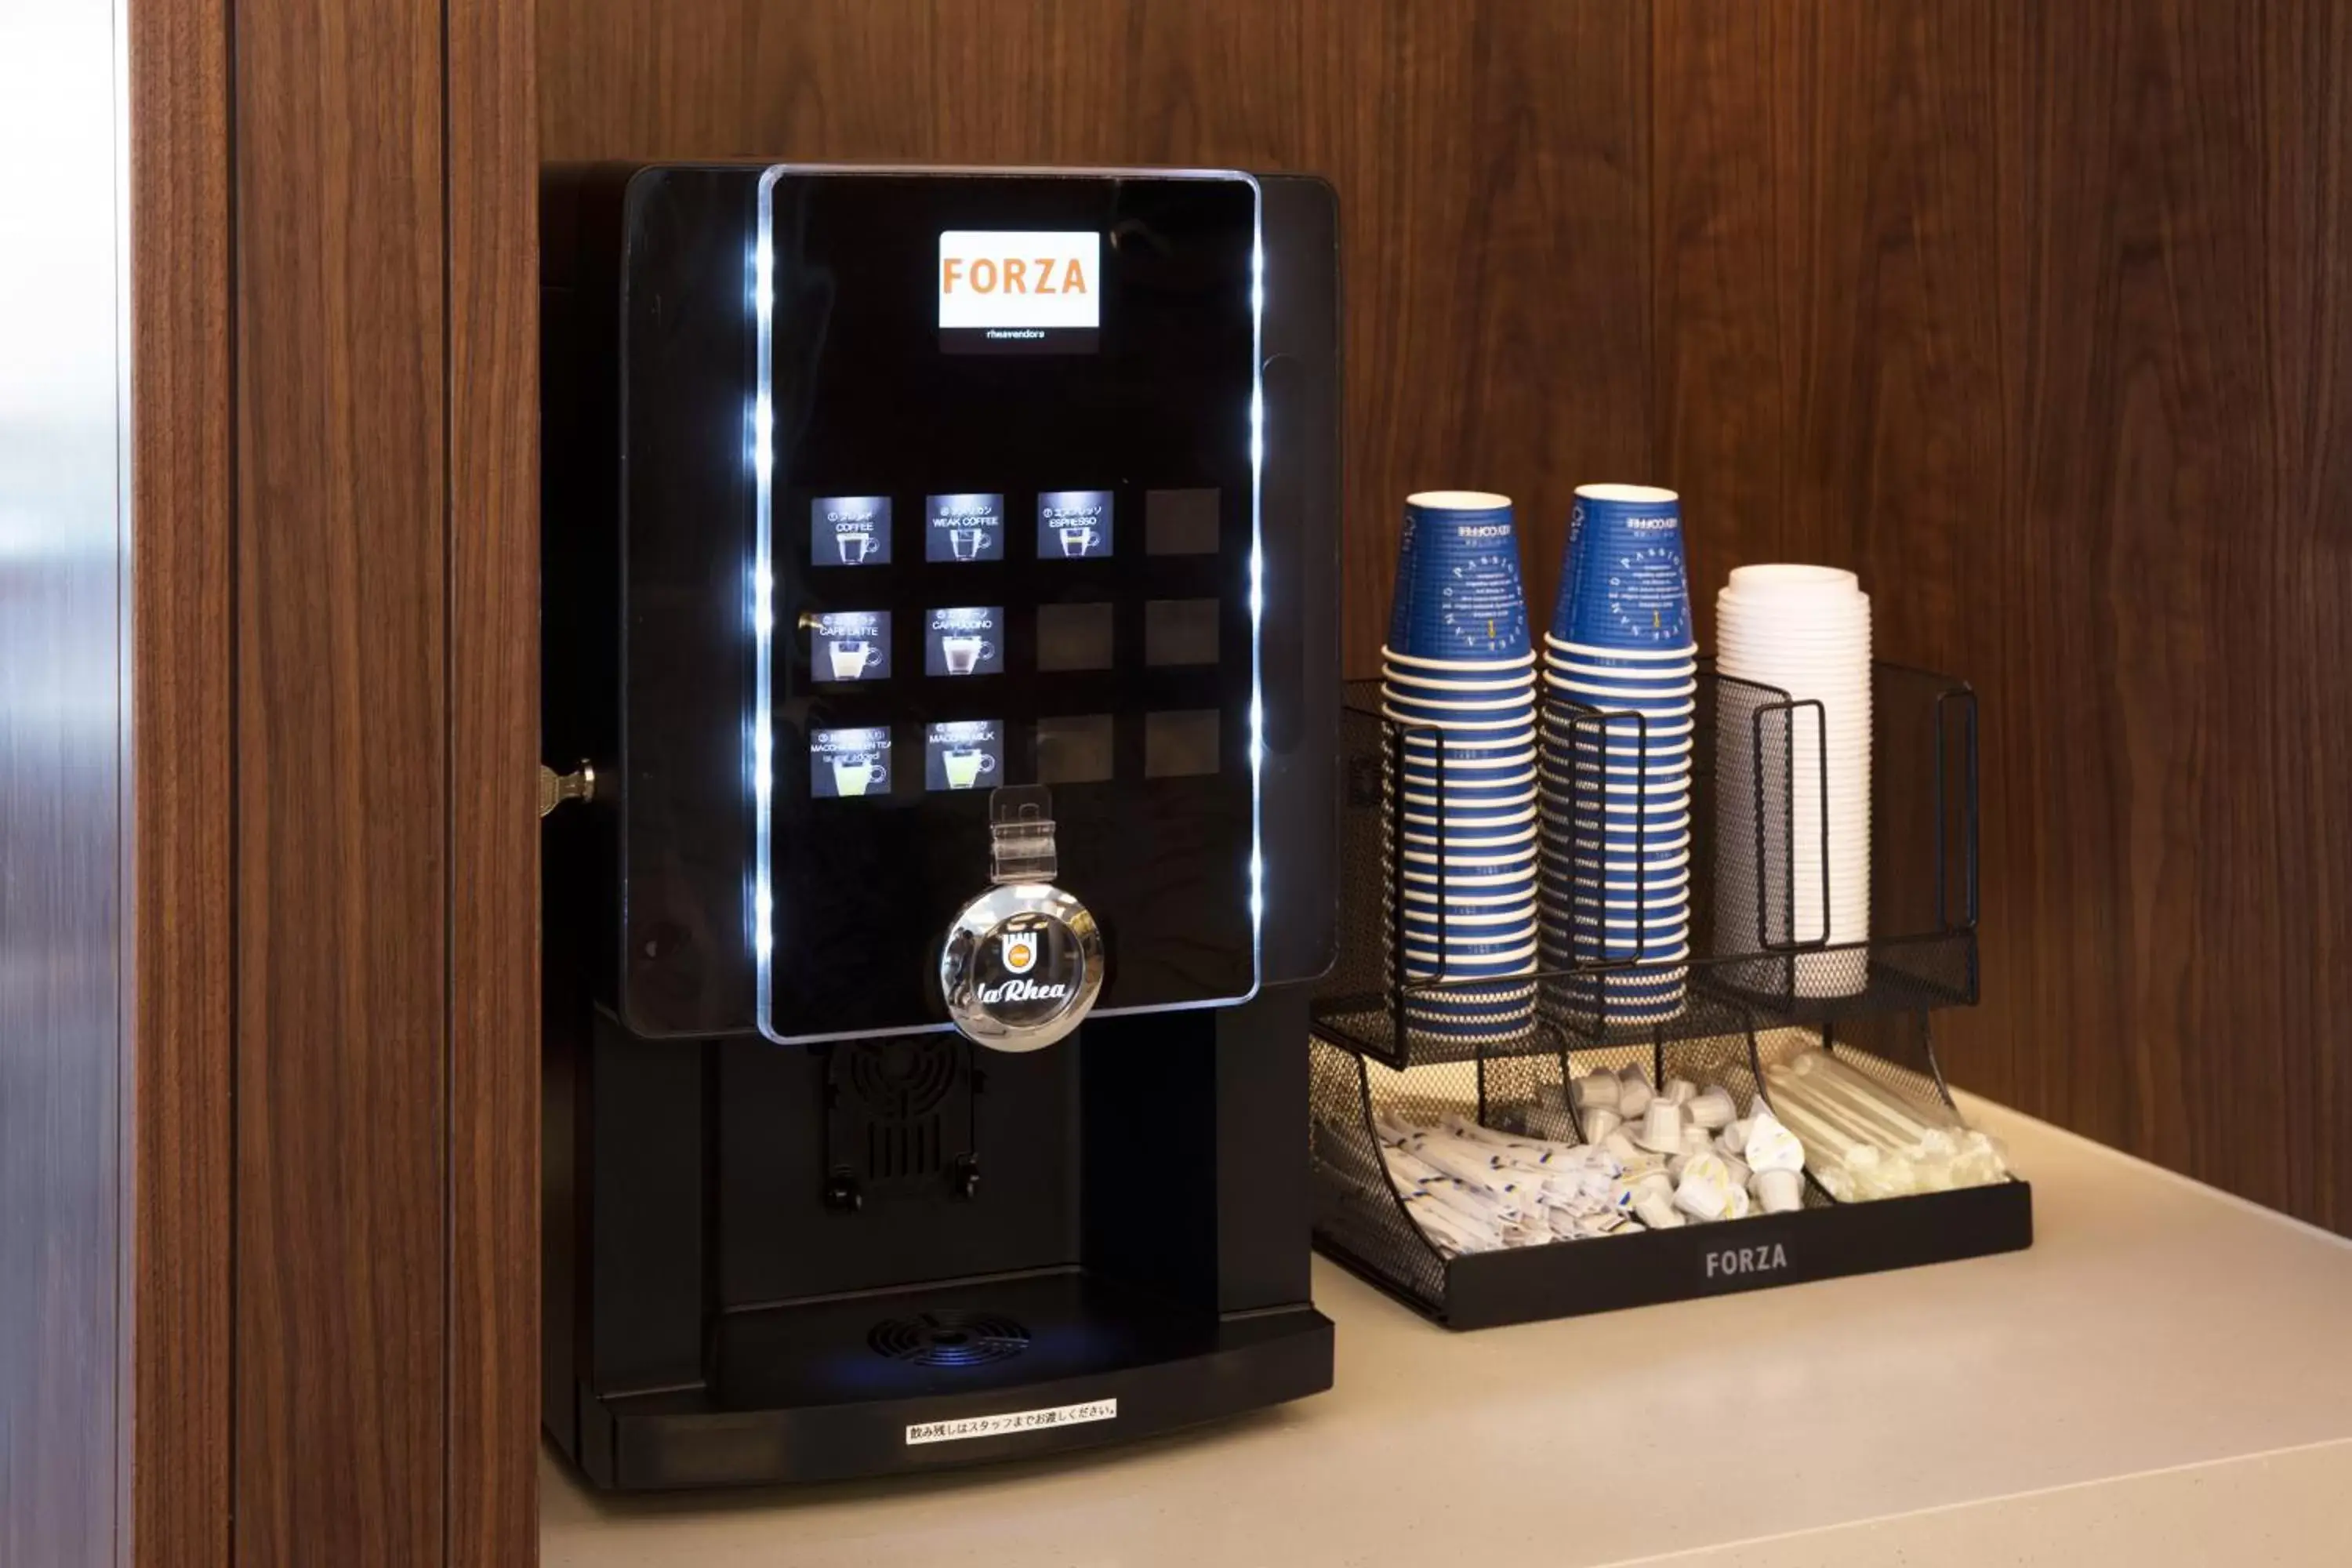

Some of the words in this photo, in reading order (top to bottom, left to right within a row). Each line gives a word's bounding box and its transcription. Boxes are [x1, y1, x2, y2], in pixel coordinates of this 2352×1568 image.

[942, 258, 1087, 294] FORZA
[835, 521, 874, 532] COFFEE
[932, 517, 960, 528] WEAK
[962, 515, 999, 526] COFFEE
[1049, 517, 1097, 528] ESPRESSO
[1706, 1243, 1788, 1278] FORZA
[910, 1406, 1114, 1440] 飲み残しはスタッフまでお渡しください。
